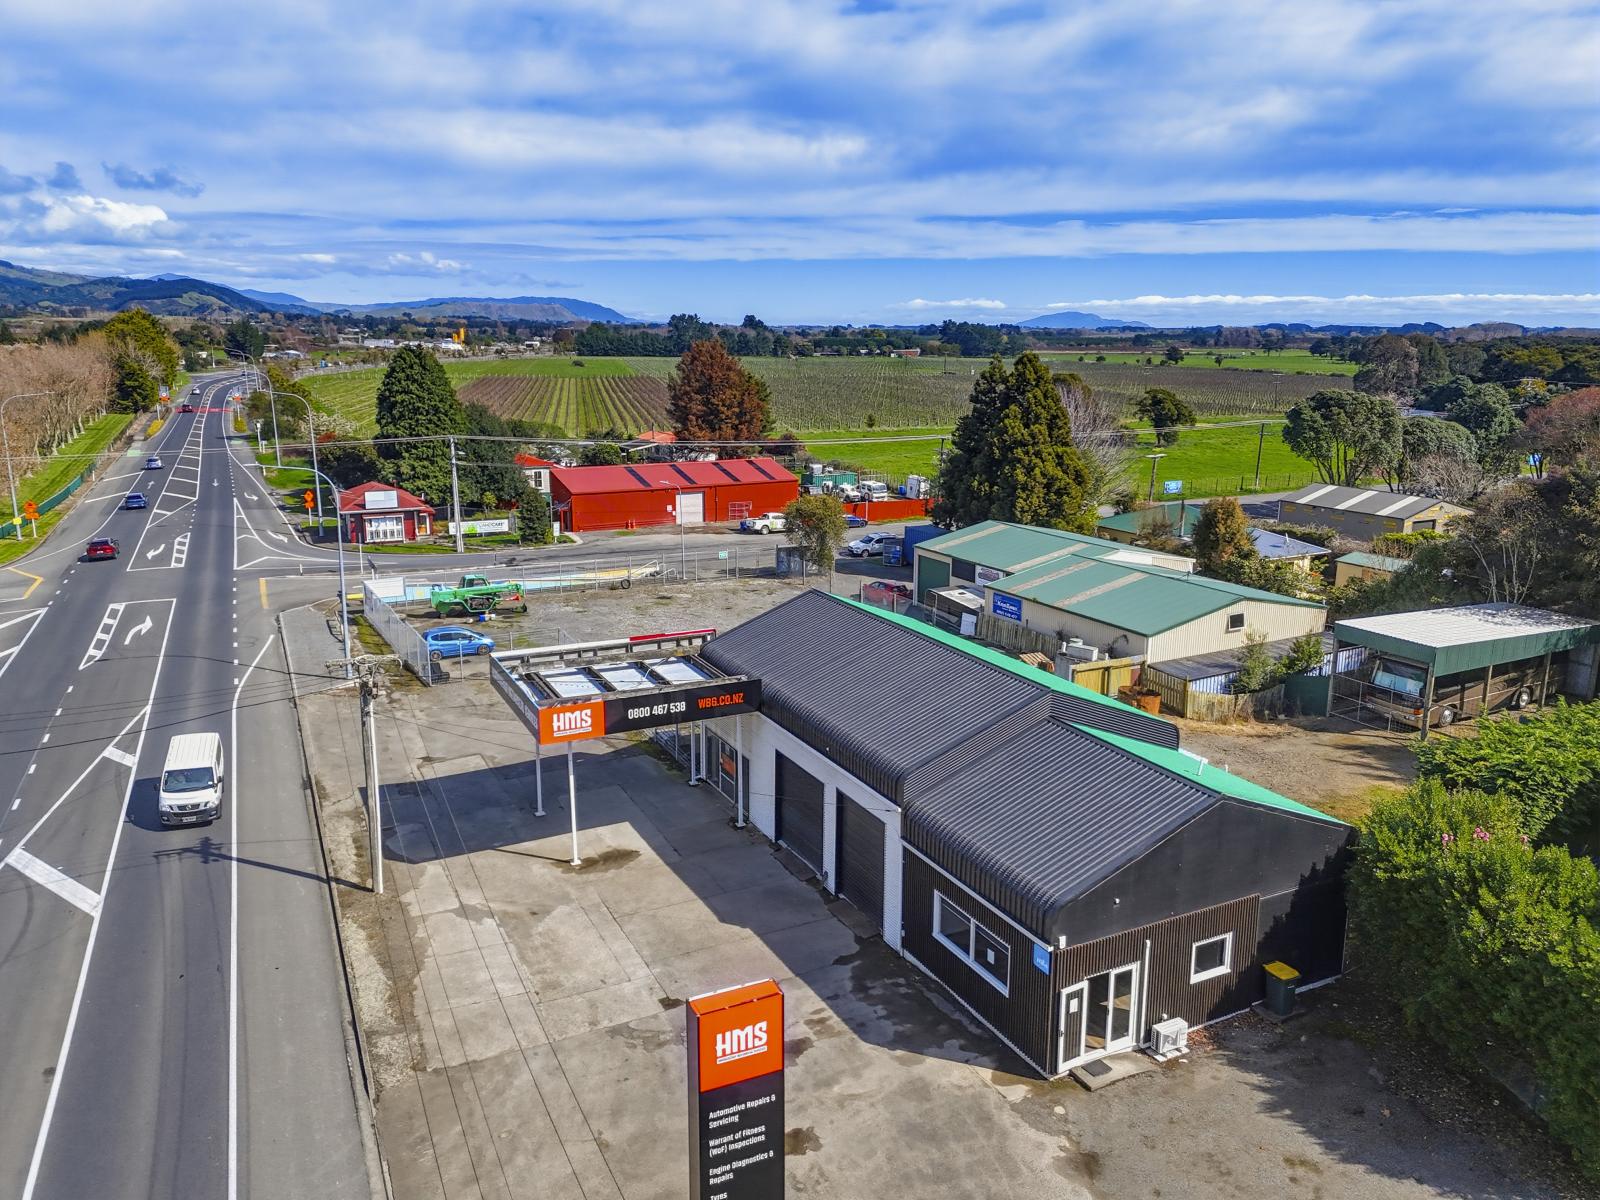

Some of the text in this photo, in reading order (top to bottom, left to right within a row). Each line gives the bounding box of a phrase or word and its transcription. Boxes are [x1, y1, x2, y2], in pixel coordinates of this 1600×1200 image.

[552, 709, 592, 731] HMS
[627, 706, 650, 719] 0800
[652, 703, 668, 715] 467
[670, 701, 686, 713] 538
[715, 1020, 768, 1057] HMS
[709, 1104, 745, 1119] Automotive
[746, 1096, 770, 1108] Repairs
[709, 1114, 739, 1129] Servicing
[709, 1125, 766, 1147] Warrant of Fitness
[709, 1134, 765, 1158] (WoF) Inspections
[709, 1163, 731, 1176] Engine
[732, 1152, 768, 1169] Diagnostics
[709, 1172, 734, 1185] Repairs
[710, 1192, 728, 1200] Tyres
